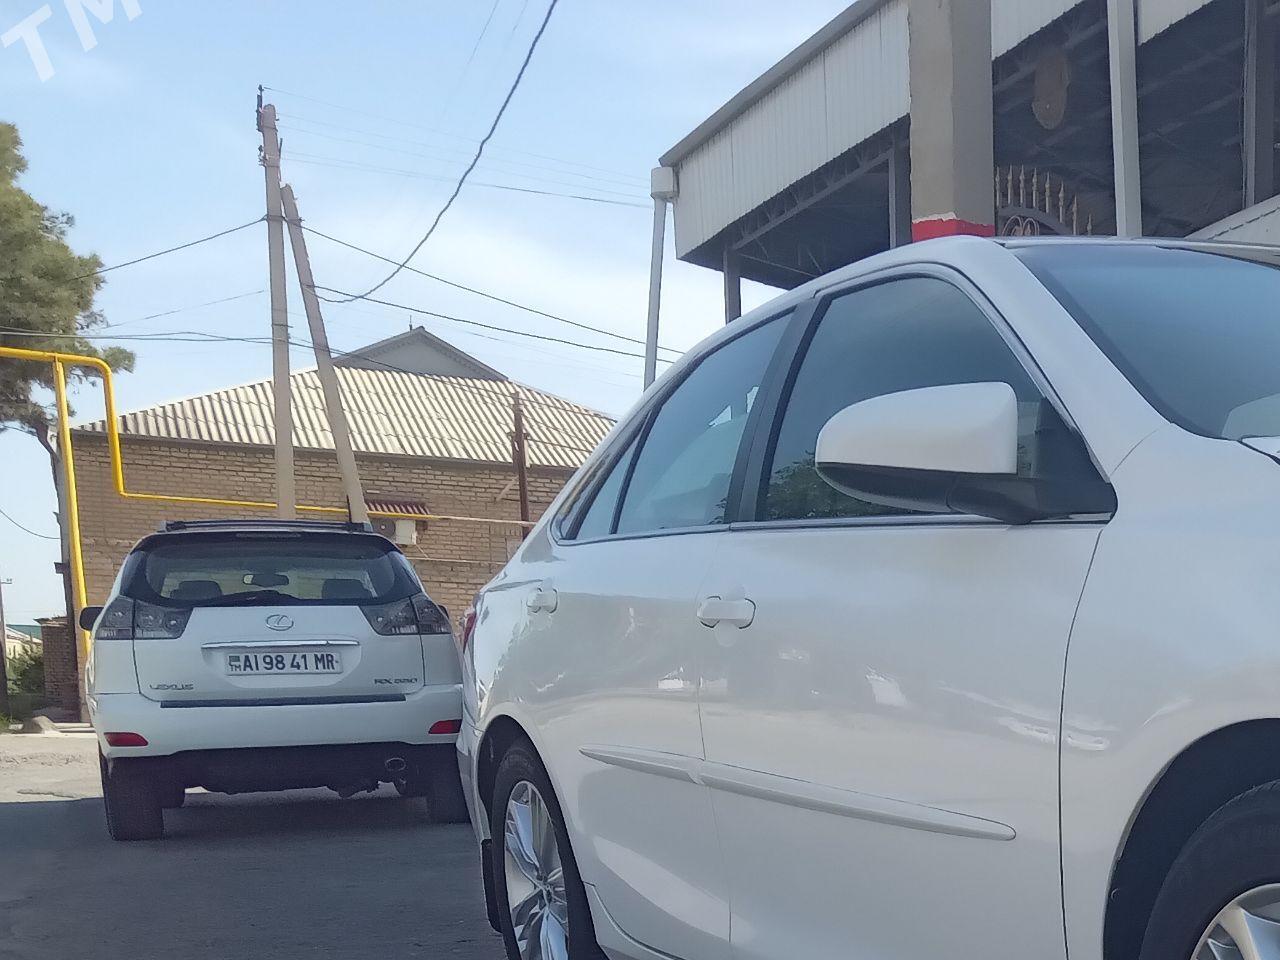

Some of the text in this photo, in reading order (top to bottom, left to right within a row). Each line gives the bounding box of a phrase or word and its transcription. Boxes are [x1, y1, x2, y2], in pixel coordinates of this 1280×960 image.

[242, 653, 336, 672] AI 98 41 MR
